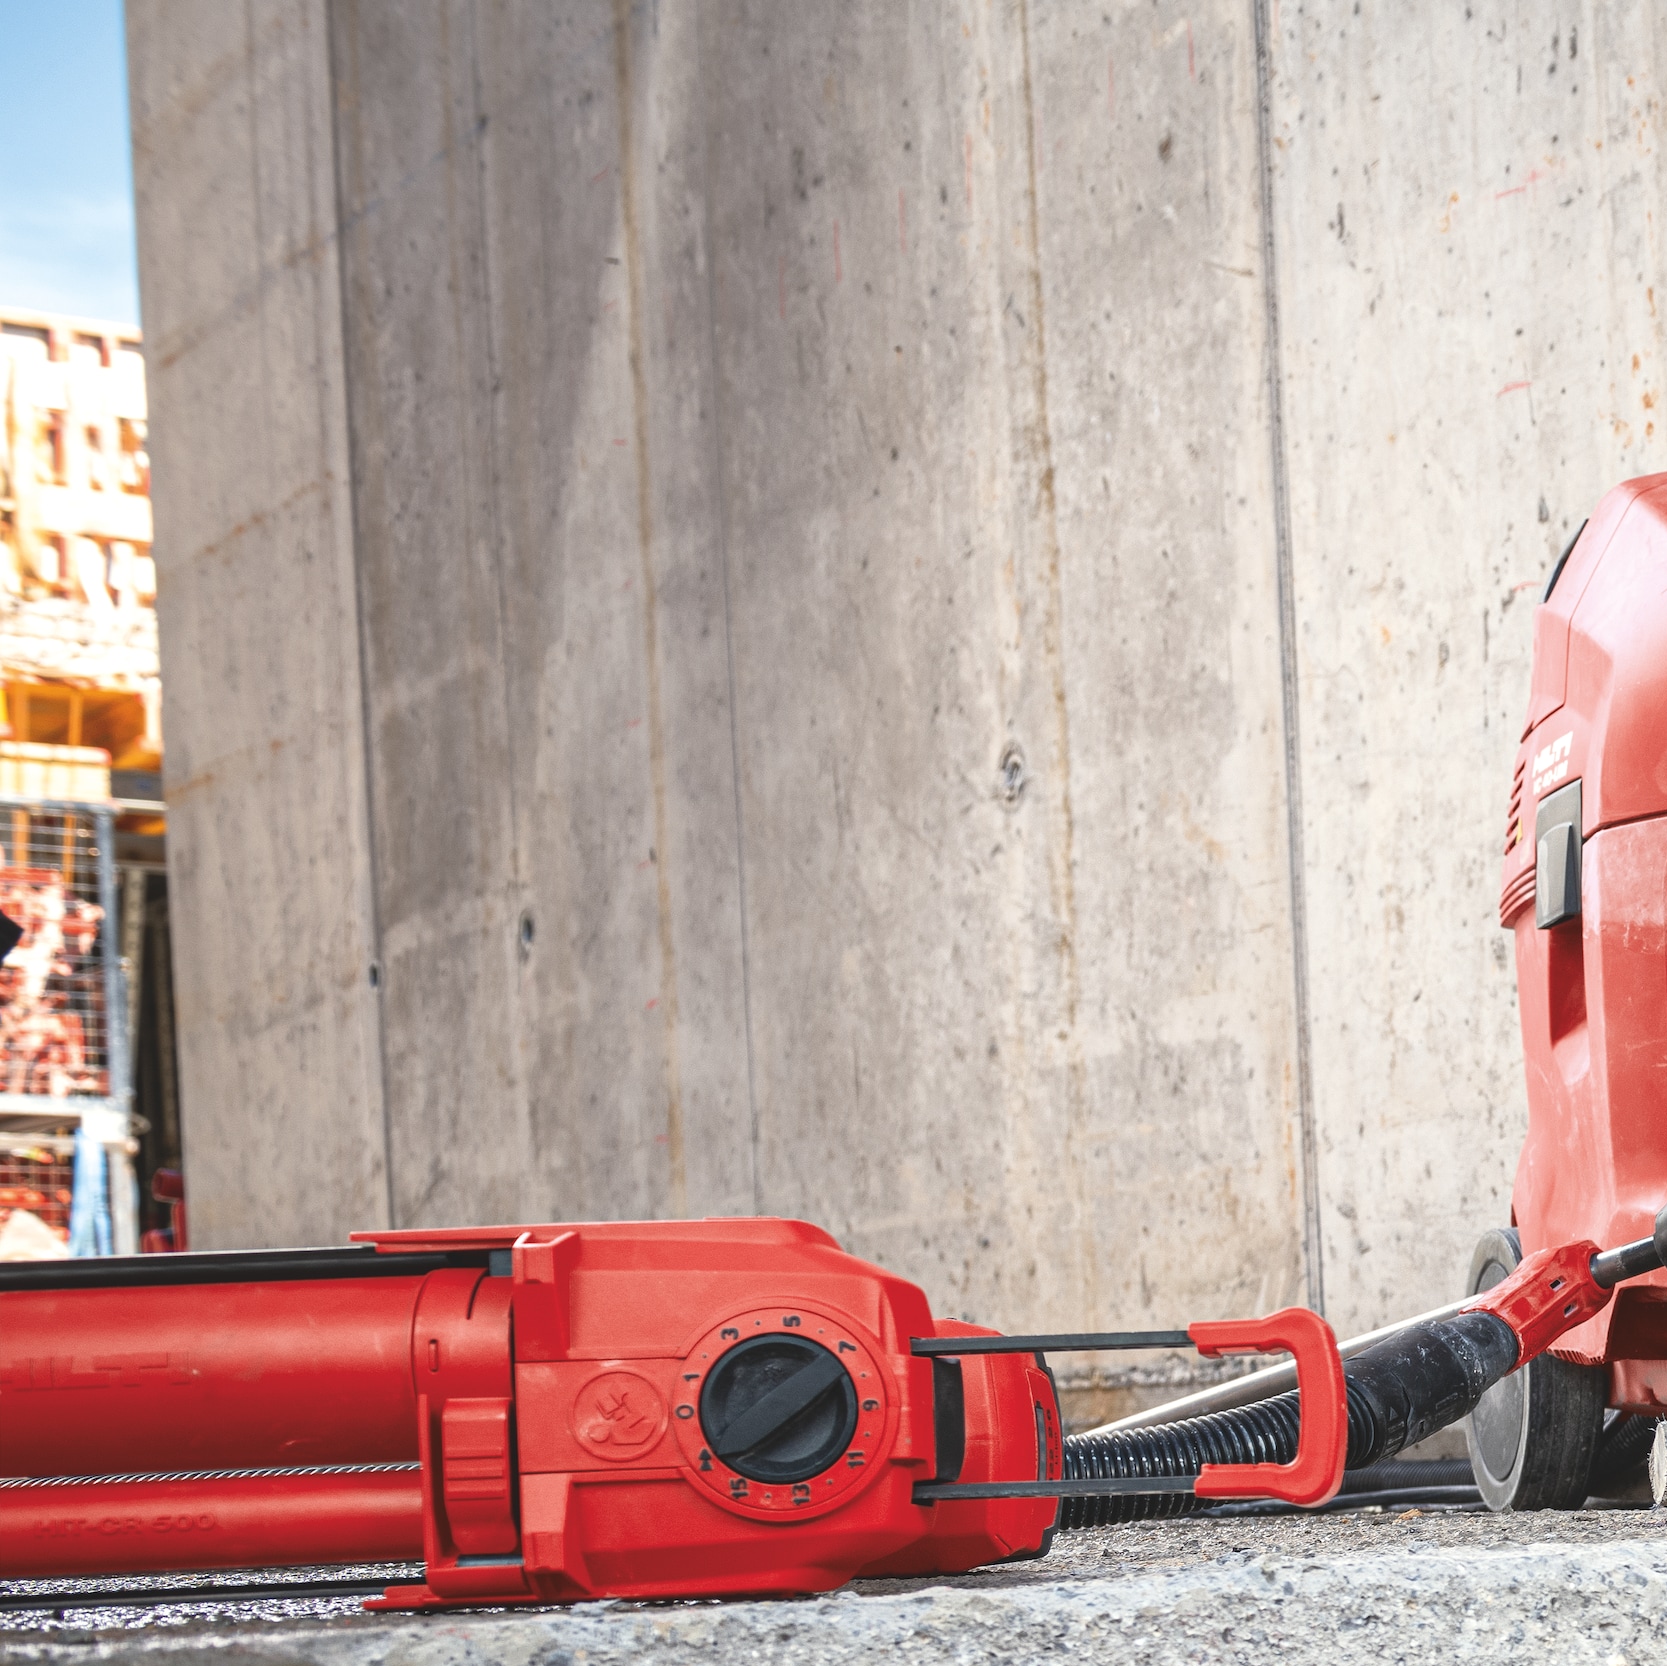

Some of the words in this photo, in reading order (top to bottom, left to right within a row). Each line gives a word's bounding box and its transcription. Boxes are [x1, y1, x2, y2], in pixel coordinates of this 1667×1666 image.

[782, 1315, 801, 1327] 5
[721, 1327, 740, 1340] 3
[838, 1340, 857, 1353] 7
[683, 1373, 700, 1382] 1
[675, 1404, 695, 1420] 0
[846, 1451, 865, 1469] 11
[729, 1478, 749, 1499] 15
[791, 1483, 811, 1505] 13
[152, 1512, 218, 1533] 500
